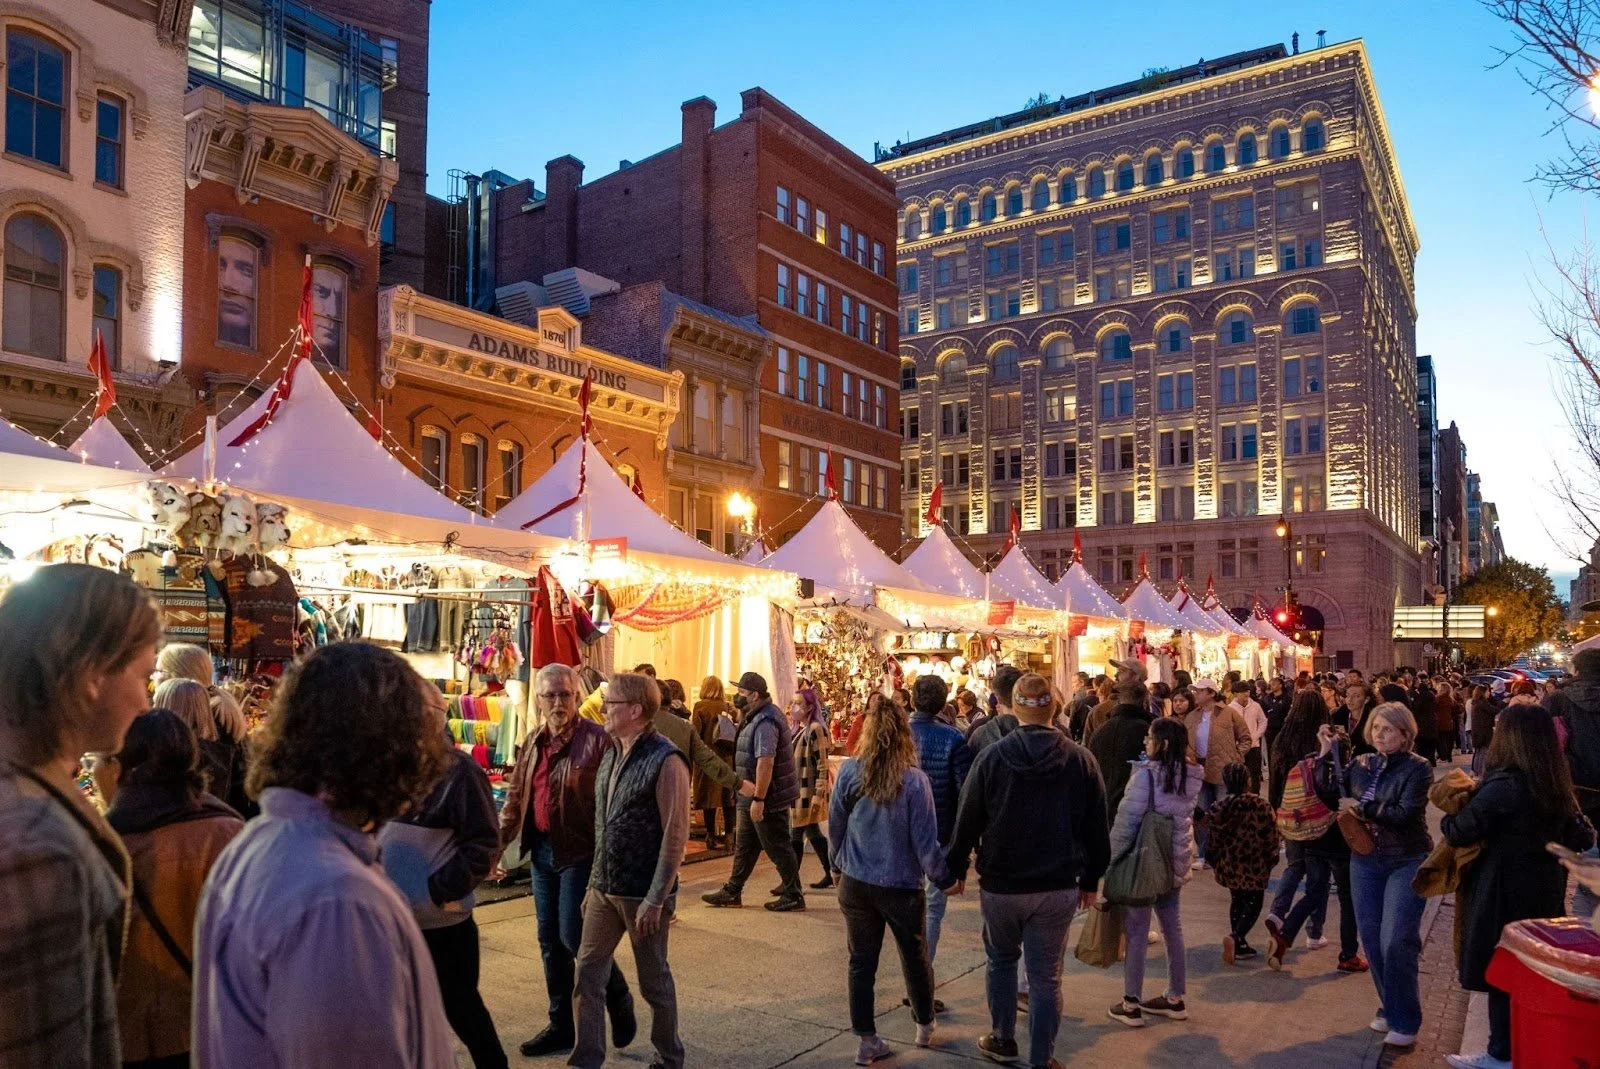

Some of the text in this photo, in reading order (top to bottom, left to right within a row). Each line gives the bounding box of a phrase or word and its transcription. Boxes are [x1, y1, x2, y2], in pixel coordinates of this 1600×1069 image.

[543, 329, 564, 344] 1876
[468, 332, 627, 391] ADAMS BUILDING
